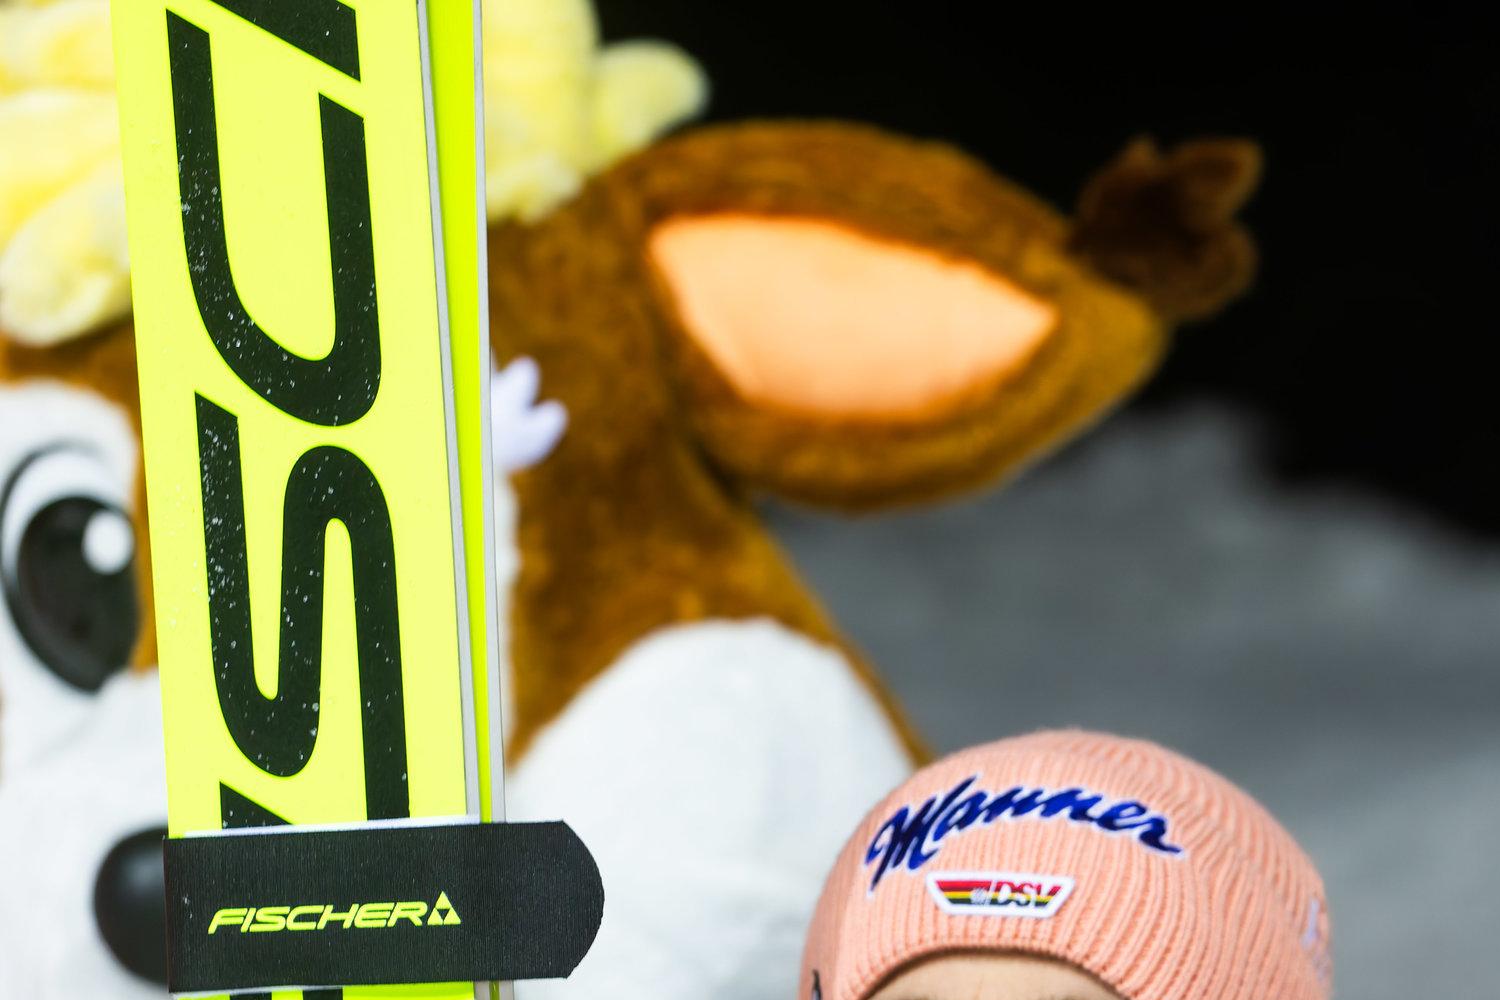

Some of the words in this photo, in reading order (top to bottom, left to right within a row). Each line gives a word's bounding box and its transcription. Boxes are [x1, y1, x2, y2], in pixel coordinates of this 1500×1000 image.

[865, 775, 1183, 892] Manner
[990, 879, 1063, 908] DSV
[207, 900, 429, 935] FISCHER
